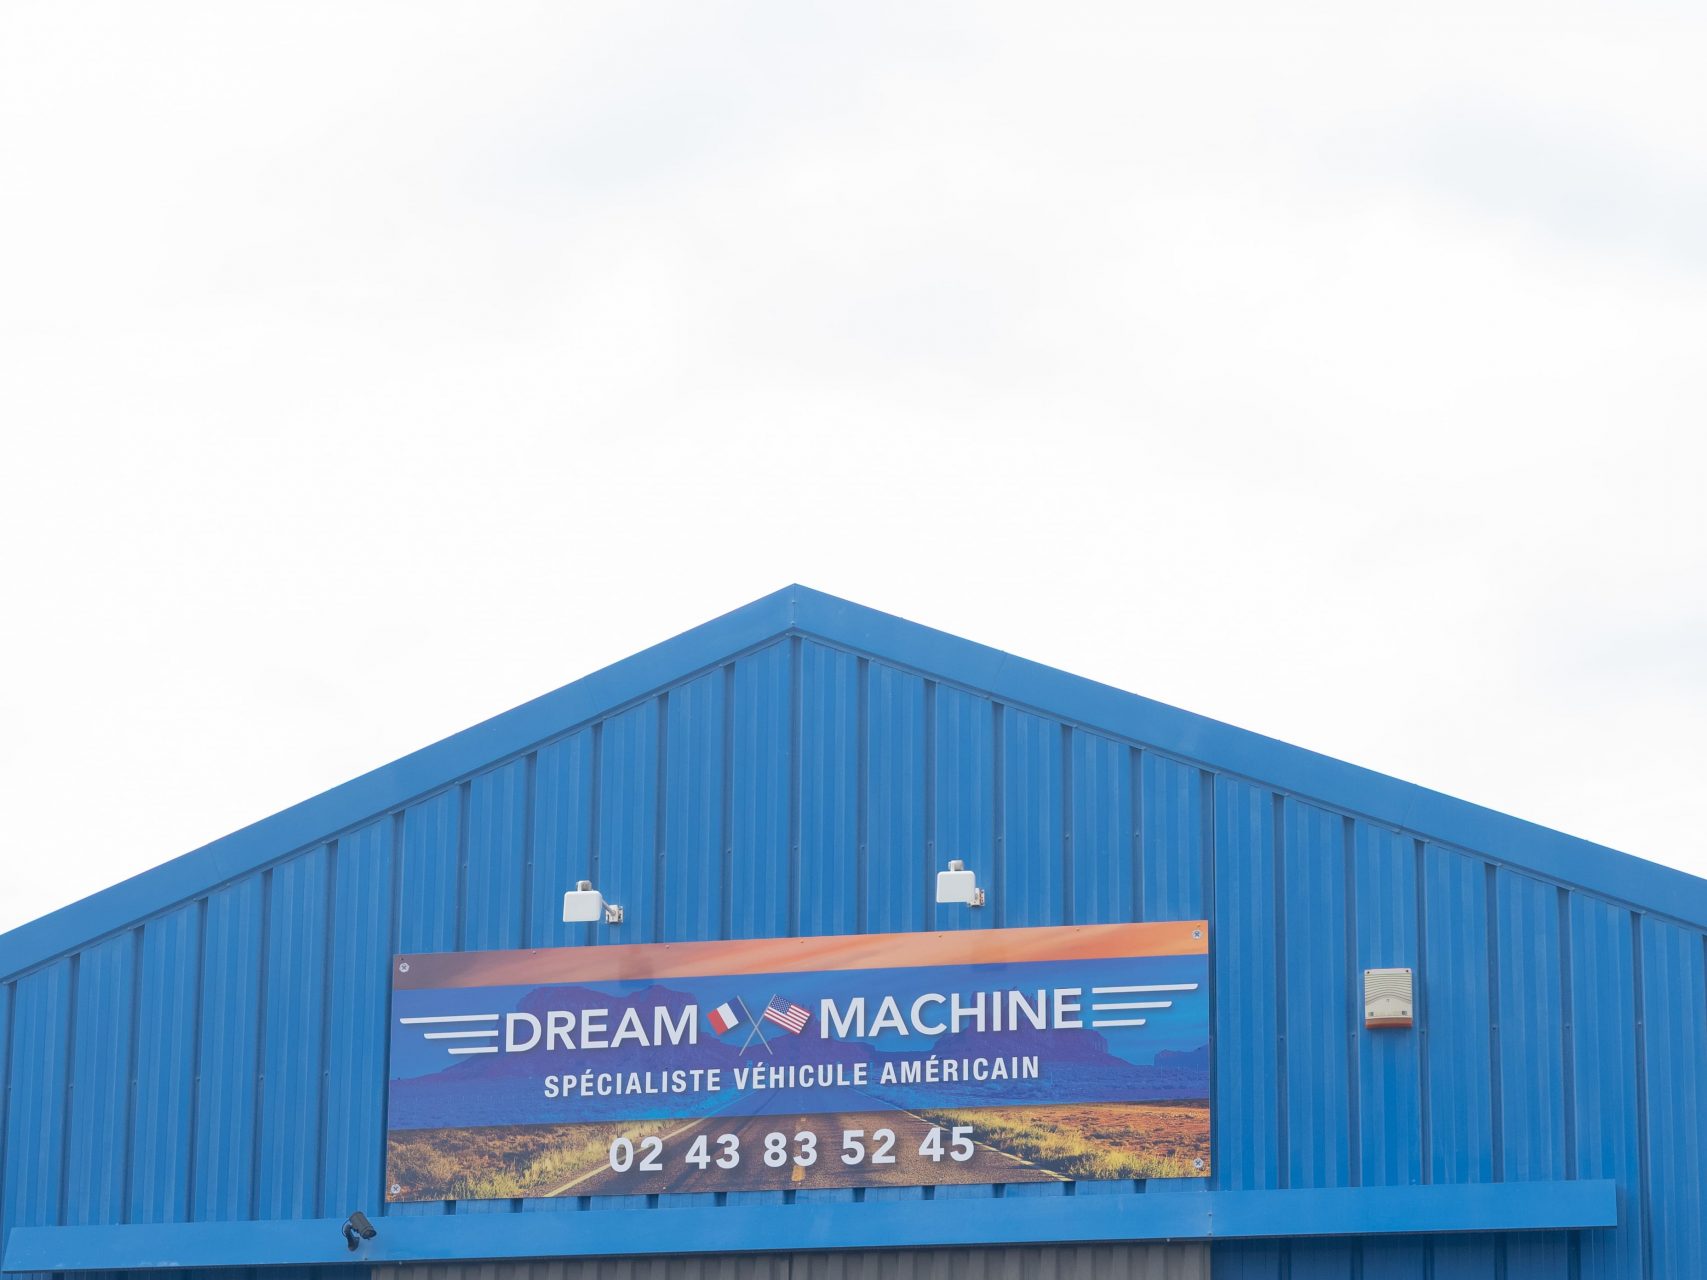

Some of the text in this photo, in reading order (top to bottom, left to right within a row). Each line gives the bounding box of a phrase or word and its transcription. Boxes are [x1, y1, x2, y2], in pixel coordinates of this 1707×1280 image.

[505, 987, 1083, 1053] DREAM MACHINE
[544, 1054, 1039, 1099] SPÉCIALISTE VÉHICULE AMÉRICAIN
[609, 1125, 975, 1173] 02 43 83 52 45
